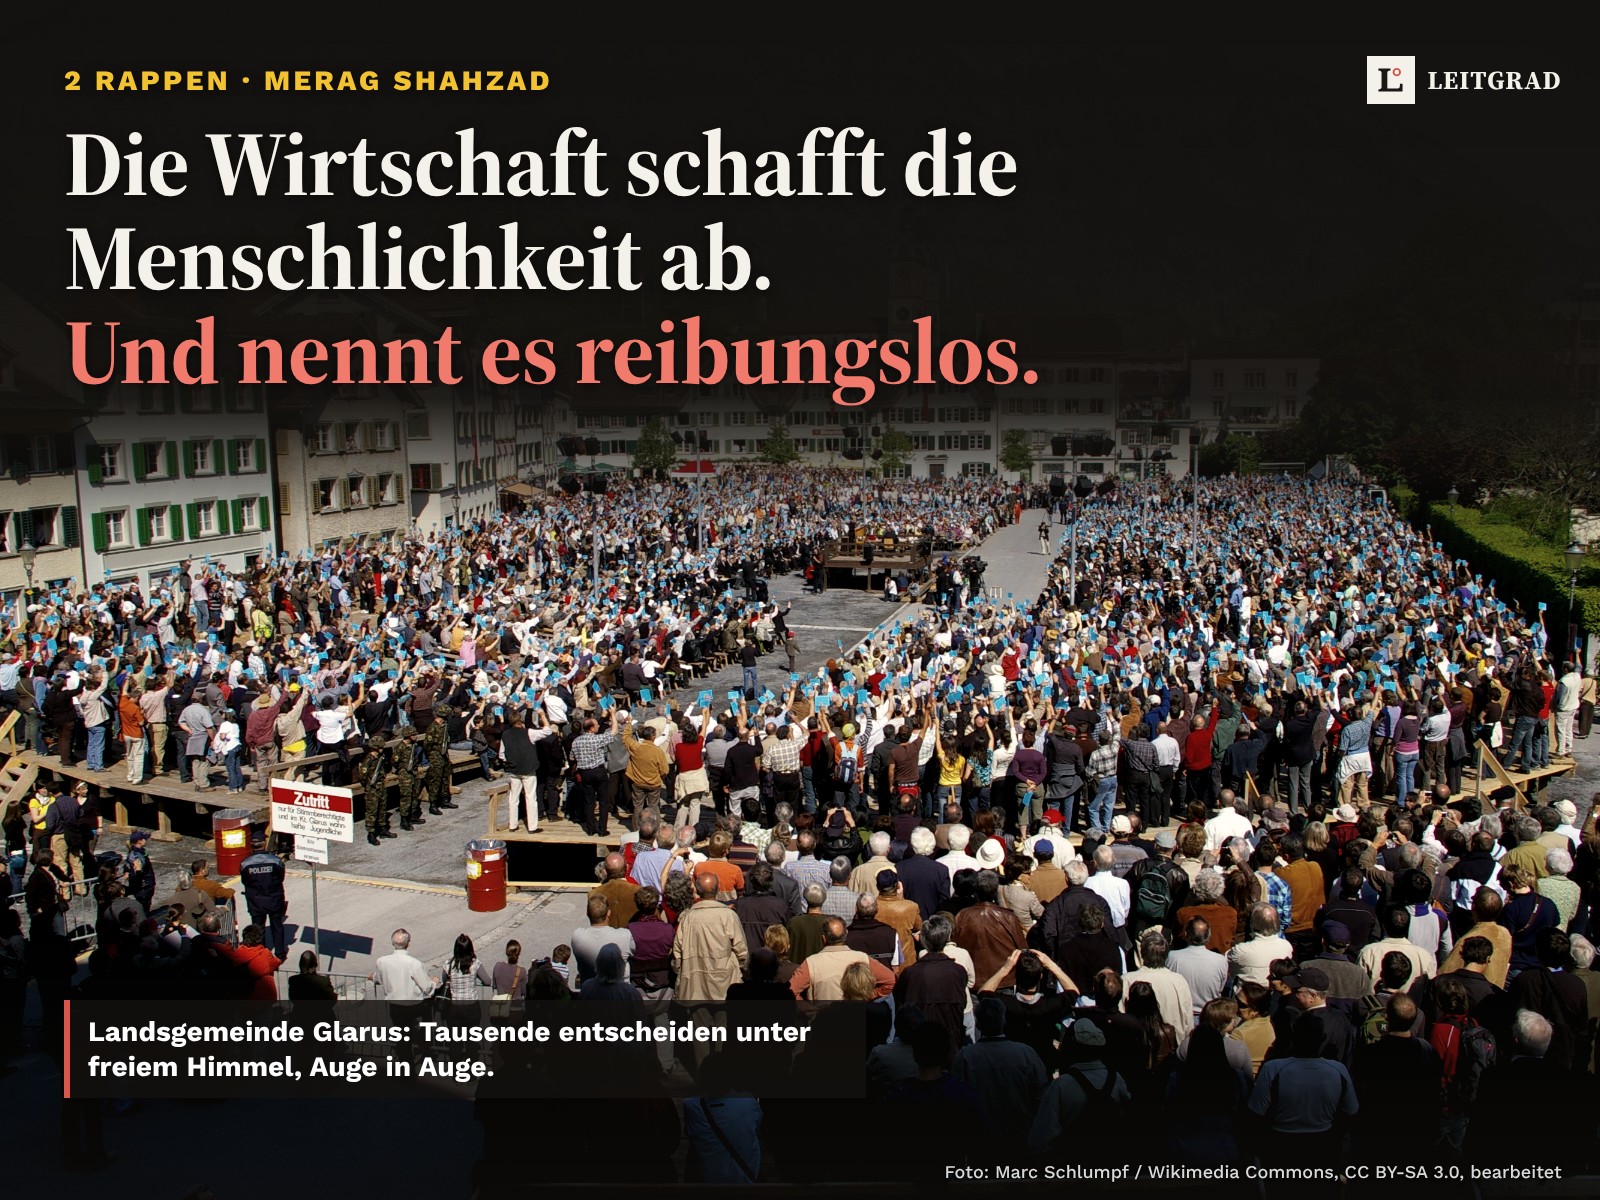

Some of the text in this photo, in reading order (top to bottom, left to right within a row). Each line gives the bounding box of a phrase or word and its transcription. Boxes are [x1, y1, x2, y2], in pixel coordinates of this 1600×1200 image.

[293, 791, 330, 809] Zutritt
[310, 823, 343, 836] Jugendliche
[248, 865, 274, 875] POLIZEI
